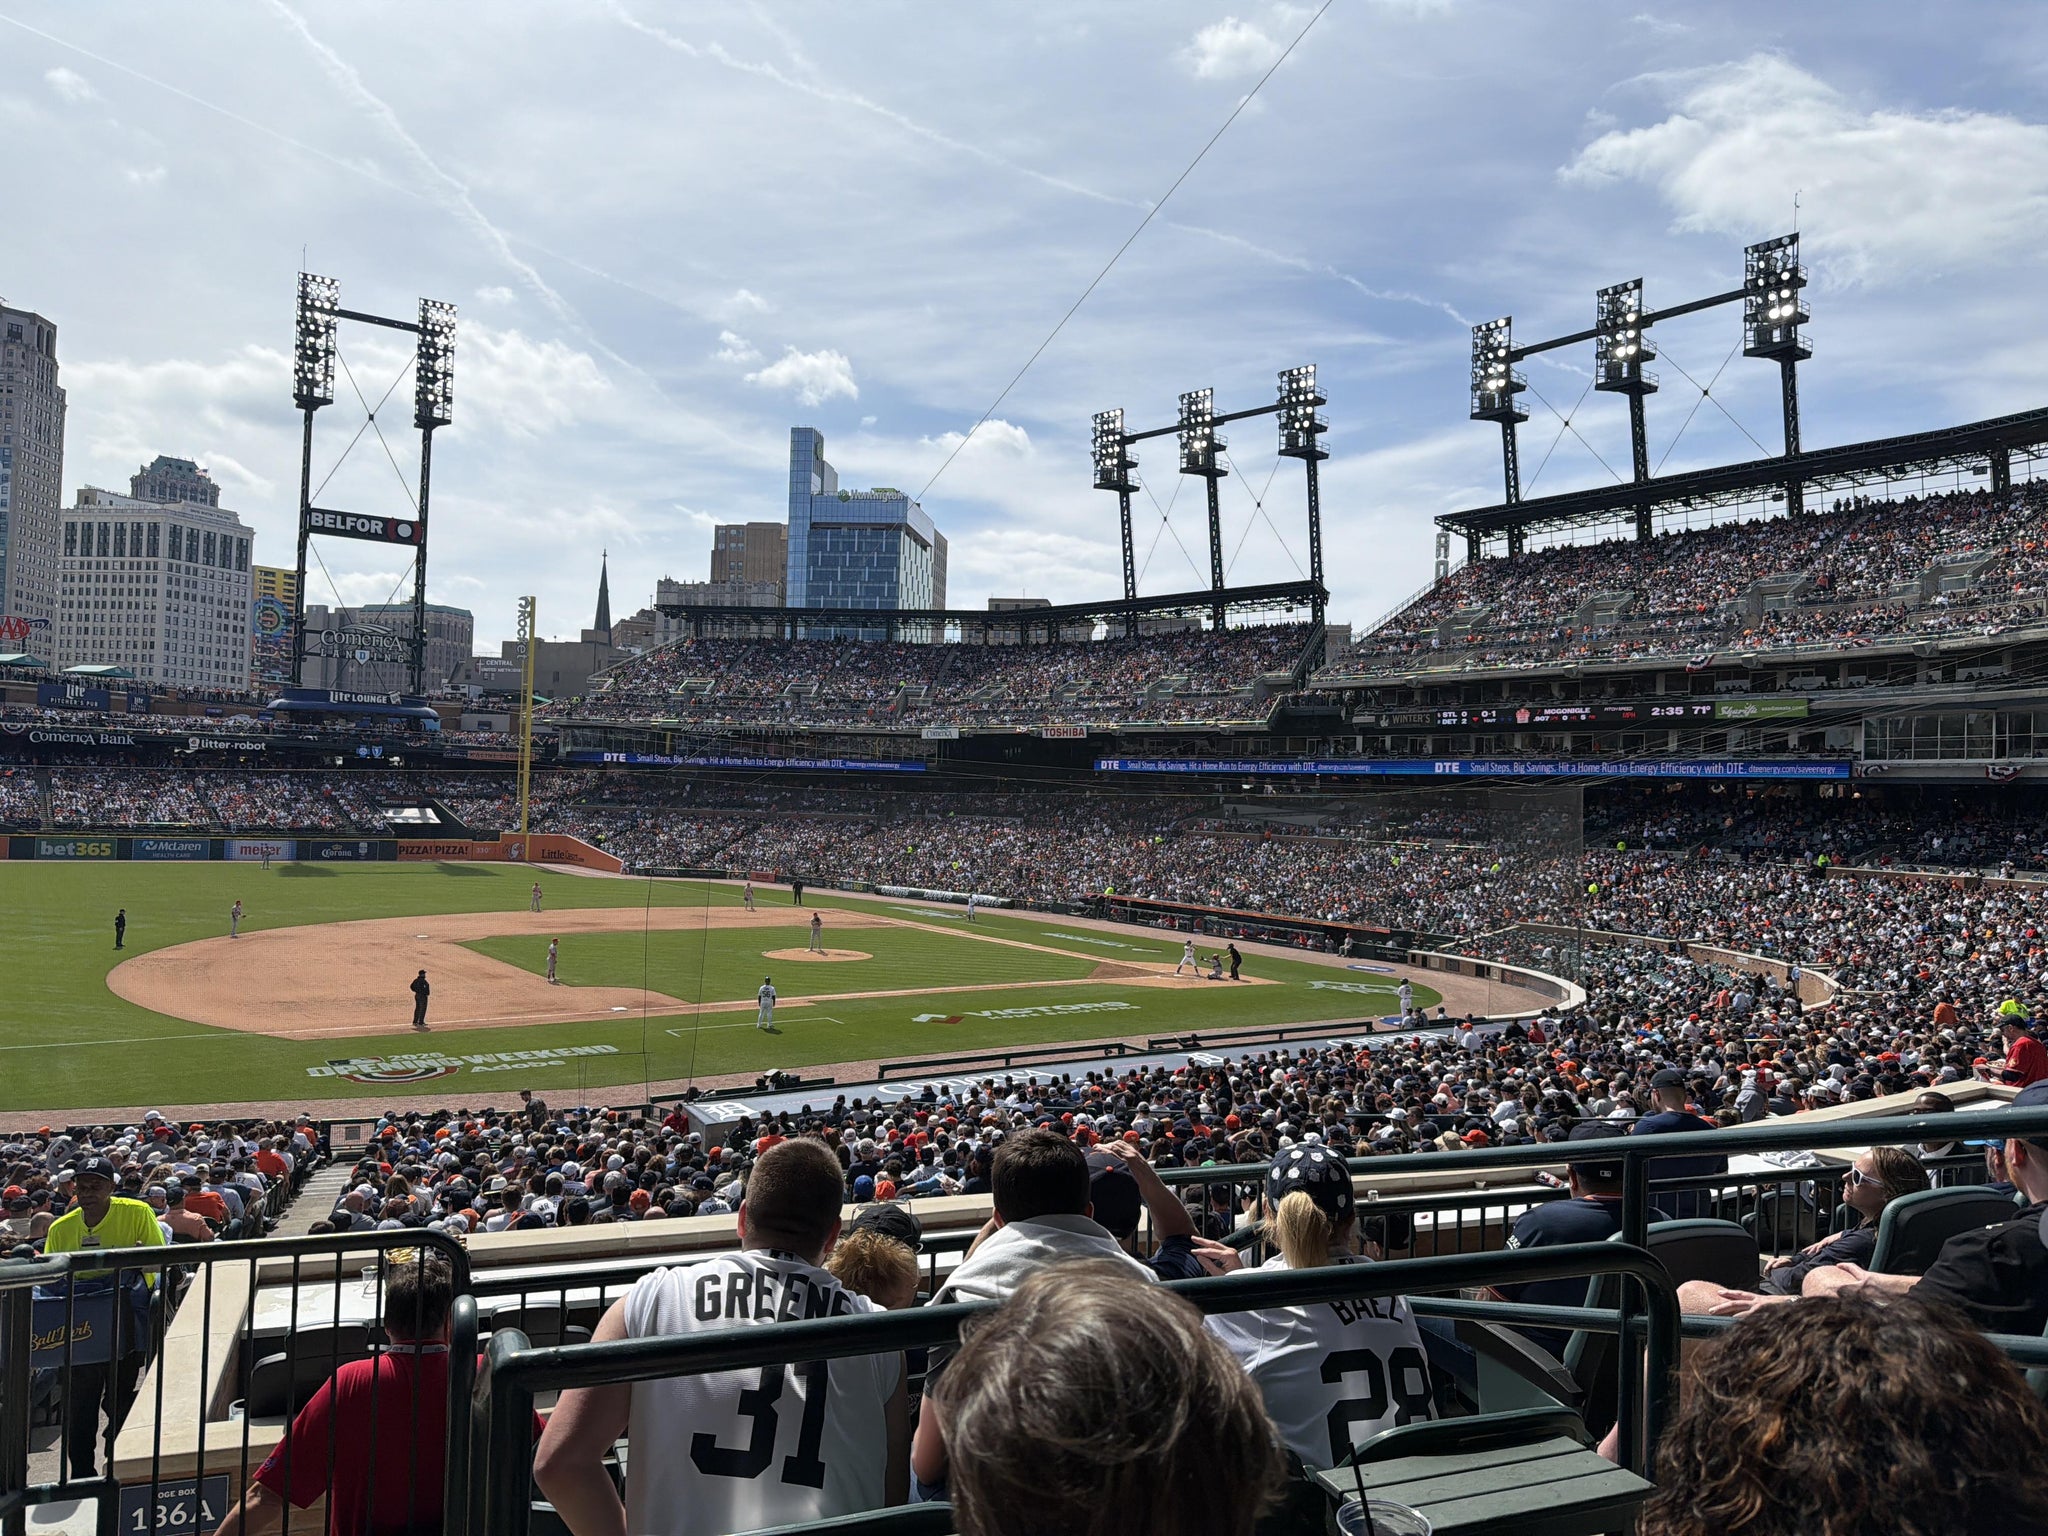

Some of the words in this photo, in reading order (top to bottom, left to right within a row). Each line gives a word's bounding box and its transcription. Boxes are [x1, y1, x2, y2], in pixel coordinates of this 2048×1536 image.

[850, 489, 904, 502] Huntington
[310, 512, 384, 534] BELFOR
[66, 684, 86, 699] Lite
[329, 691, 351, 703] Lite
[352, 695, 388, 704] LOUNGE
[1544, 707, 1591, 715] MCGONIGLE
[1651, 706, 1684, 716] 2:35
[1392, 714, 1431, 724] WINTER'S
[1044, 727, 1085, 737] TOSHIBA
[100, 733, 135, 745] Bank
[603, 753, 627, 763] DTE
[636, 754, 653, 763] Small
[673, 754, 684, 764] Big
[709, 756, 719, 765] Hit
[725, 756, 742, 765] Home
[743, 757, 755, 766] Run
[756, 758, 763, 766] to
[764, 758, 785, 768] Energy
[786, 758, 815, 768] Efficiency
[816, 759, 831, 767] with
[1101, 761, 1119, 769] DTE
[1127, 761, 1141, 770] Small
[1157, 762, 1166, 771] Big
[1189, 762, 1197, 770] Hit
[1202, 762, 1218, 770] Home
[1218, 762, 1230, 770] Run
[1238, 762, 1258, 772] Energy
[1259, 762, 1287, 772] Efficiency
[1288, 762, 1302, 771] with
[1435, 762, 1460, 773] DTE
[1470, 763, 1490, 773] Small
[1490, 763, 1511, 774] Steps,
[1513, 763, 1525, 774] Big
[1526, 763, 1557, 775] Savings.
[1558, 763, 1569, 772] Hit
[1578, 763, 1600, 773] Home
[1601, 763, 1617, 773] Run
[1619, 764, 1627, 773] to
[1630, 763, 1658, 776] Energy
[1660, 762, 1701, 775] Efficiency
[1704, 763, 1724, 774] with
[1727, 763, 1747, 774] DTE.
[1749, 765, 1836, 776] dteenergy.com/saveenergy
[41, 841, 112, 857] bet365
[157, 840, 201, 851] McLaren
[399, 845, 432, 855] PIZZA!
[435, 845, 468, 855] PIZZA!
[541, 849, 564, 859] Little
[762, 990, 771, 998] 56
[962, 1001, 1130, 1017] VICTORS
[306, 1056, 465, 1077] OPENING
[464, 1044, 620, 1064] WEEKEND
[470, 1058, 567, 1073] Adobe
[695, 1267, 852, 1323] GREENE
[1320, 1347, 1433, 1468] 28
[689, 1359, 829, 1489] 31
[157, 1490, 176, 1499] OGE
[178, 1488, 197, 1497] BOX
[131, 1499, 216, 1531] 136A
